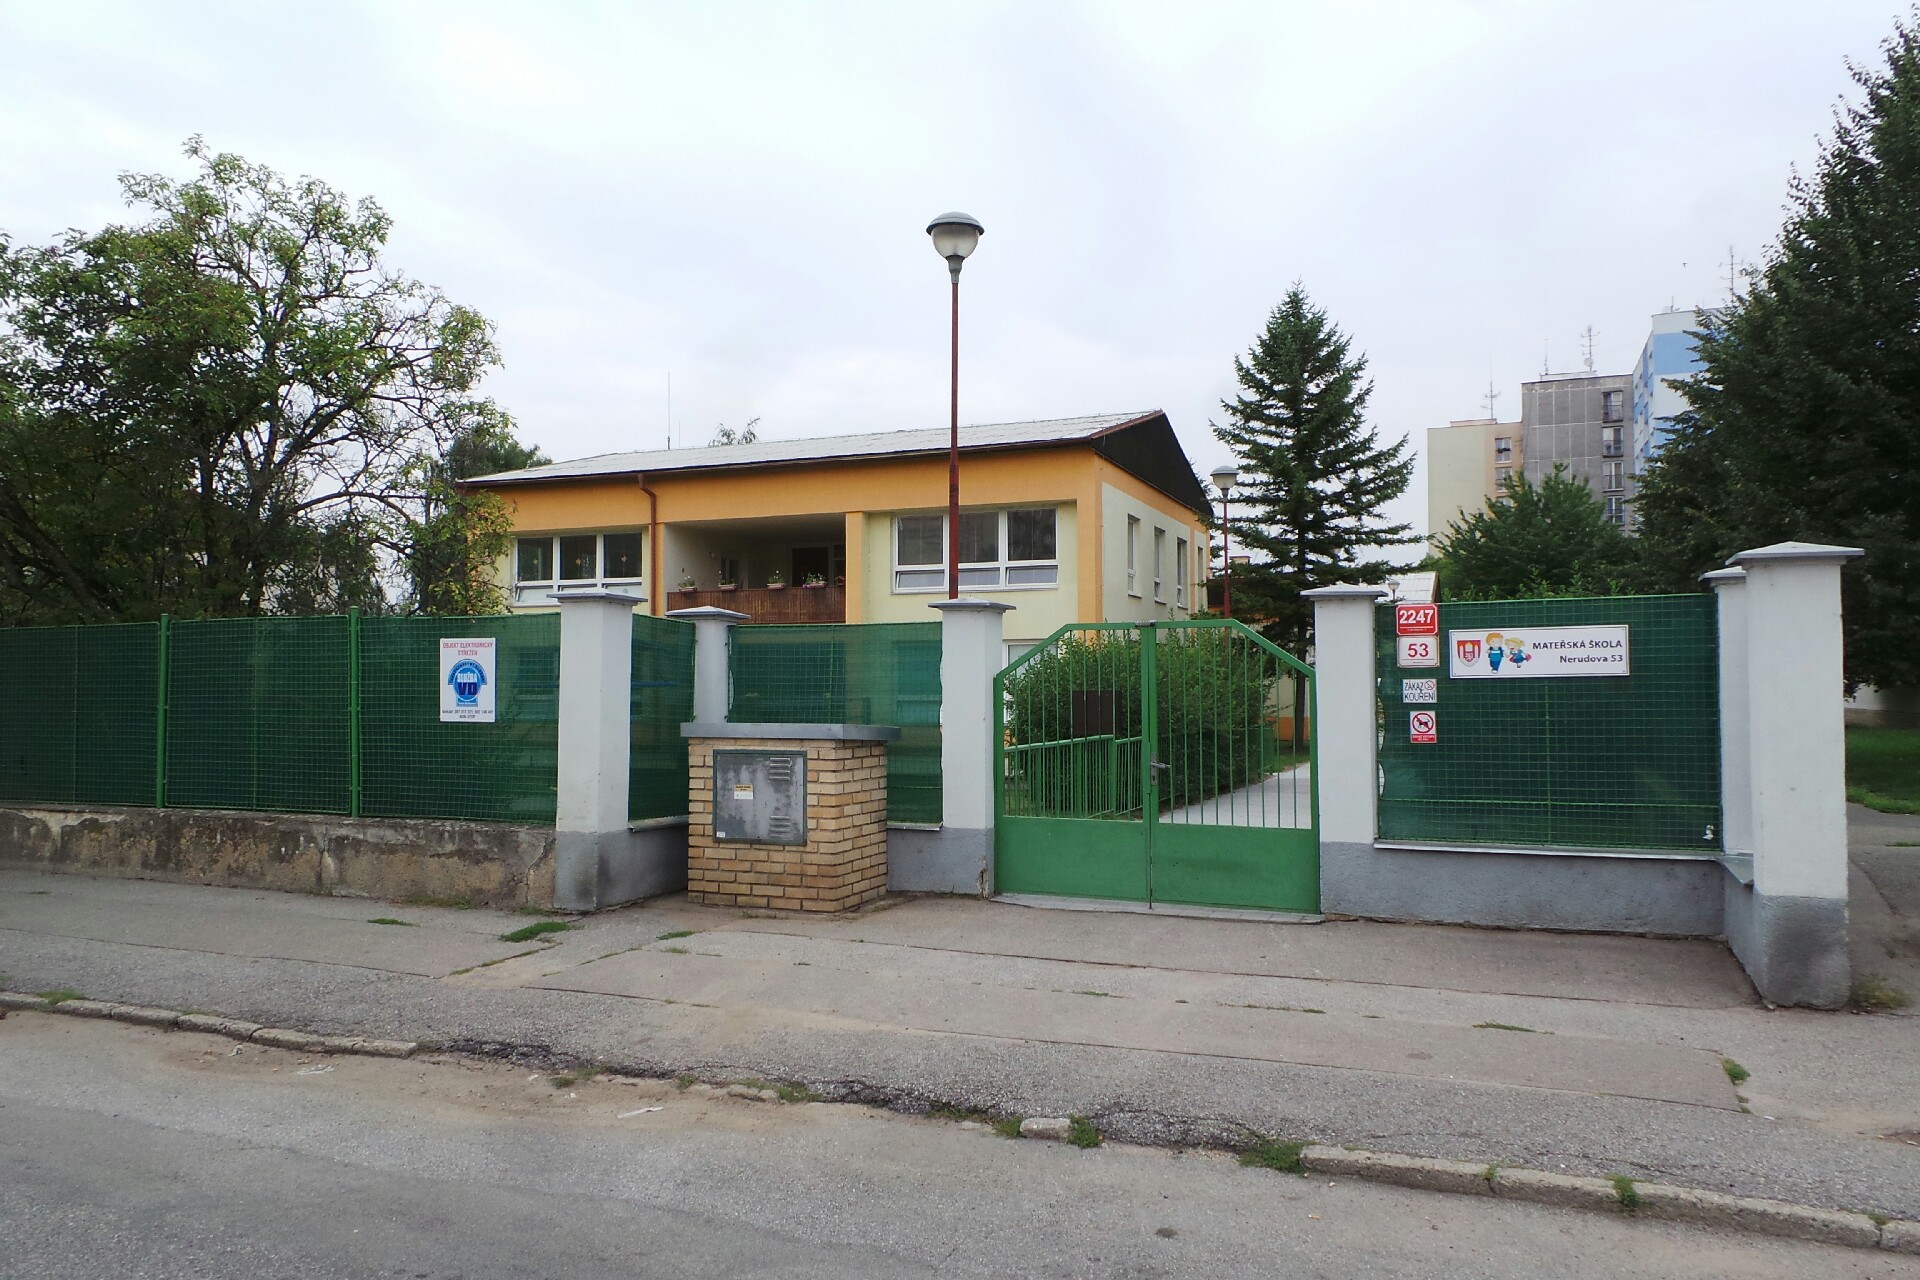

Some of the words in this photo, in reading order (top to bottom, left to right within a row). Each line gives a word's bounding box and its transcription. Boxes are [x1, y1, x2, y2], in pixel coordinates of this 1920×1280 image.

[1399, 609, 1434, 624] 2247
[1407, 643, 1429, 658] 53
[1532, 639, 1586, 650] MATEŘSKÁ
[1588, 639, 1623, 649] ŠKOLA
[1559, 654, 1609, 663] Nerudova
[1610, 654, 1623, 663] 53
[457, 682, 478, 696] VD
[1404, 679, 1424, 691] ZÁKAZ
